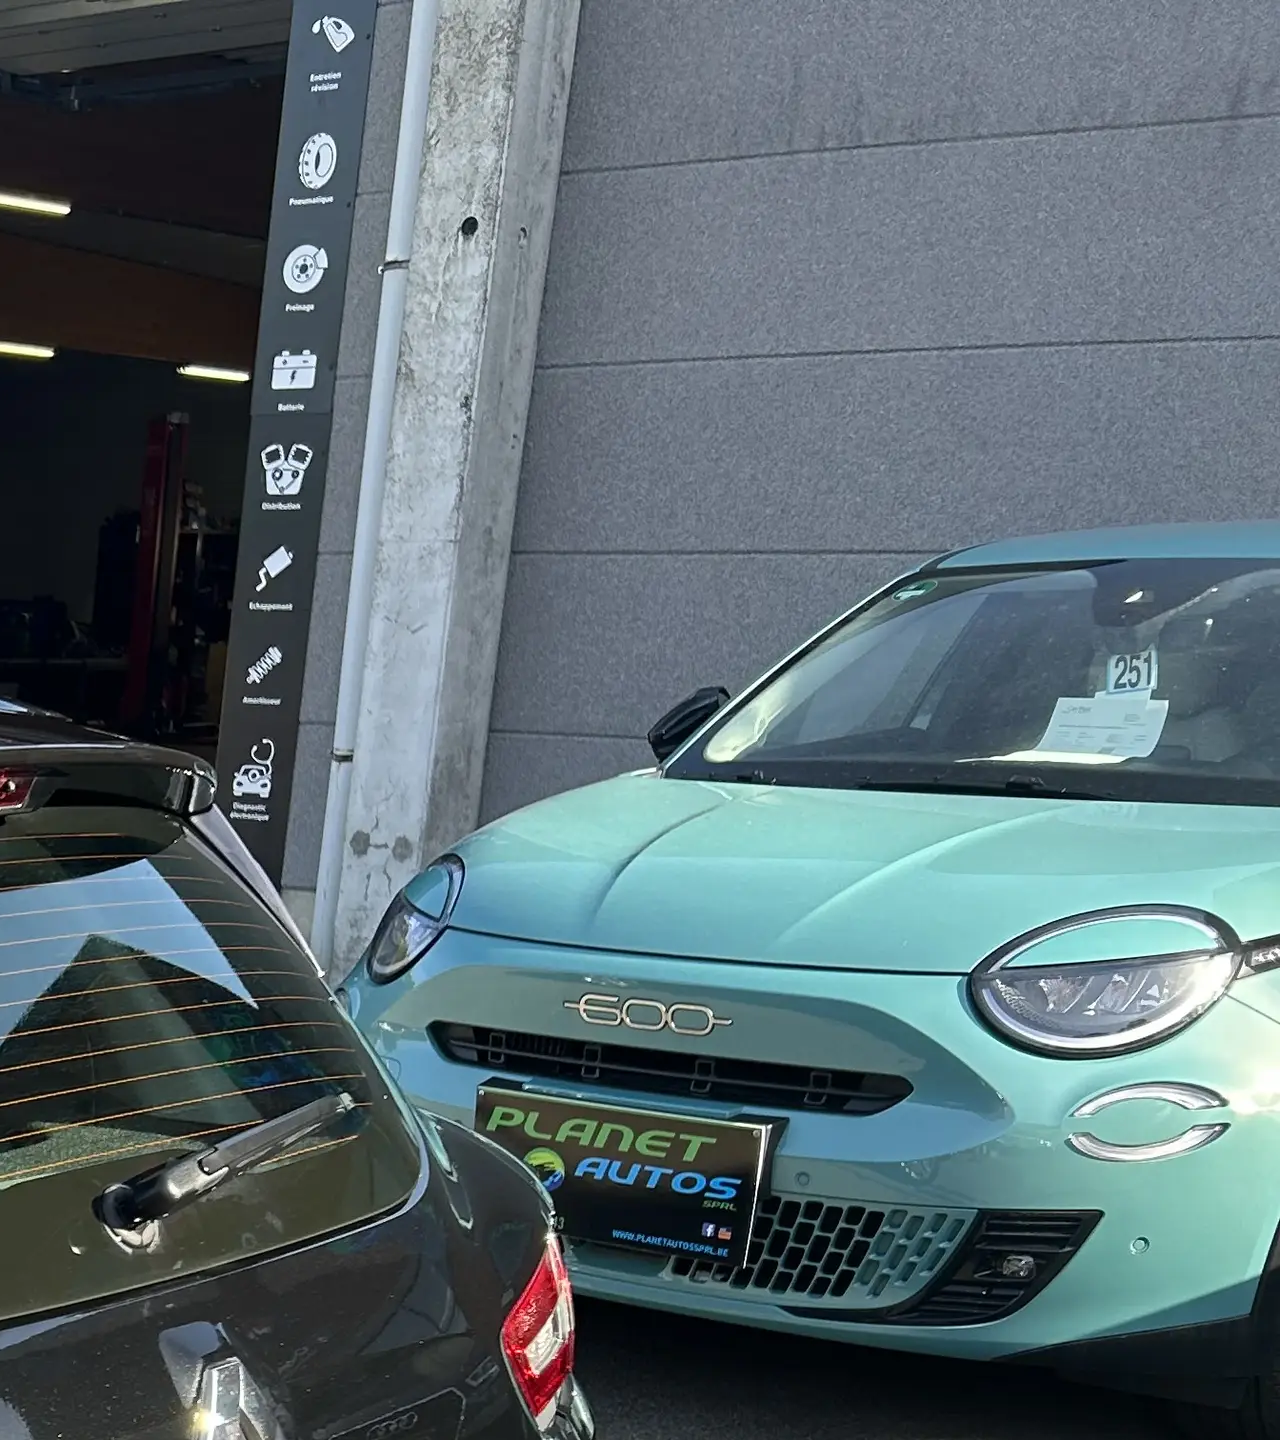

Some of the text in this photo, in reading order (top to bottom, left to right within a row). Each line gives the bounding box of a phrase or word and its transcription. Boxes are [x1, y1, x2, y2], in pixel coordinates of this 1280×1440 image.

[1114, 652, 1153, 690] 251
[577, 992, 716, 1036] 600
[486, 1106, 717, 1162] PLANET
[574, 1157, 743, 1200] AUTOS
